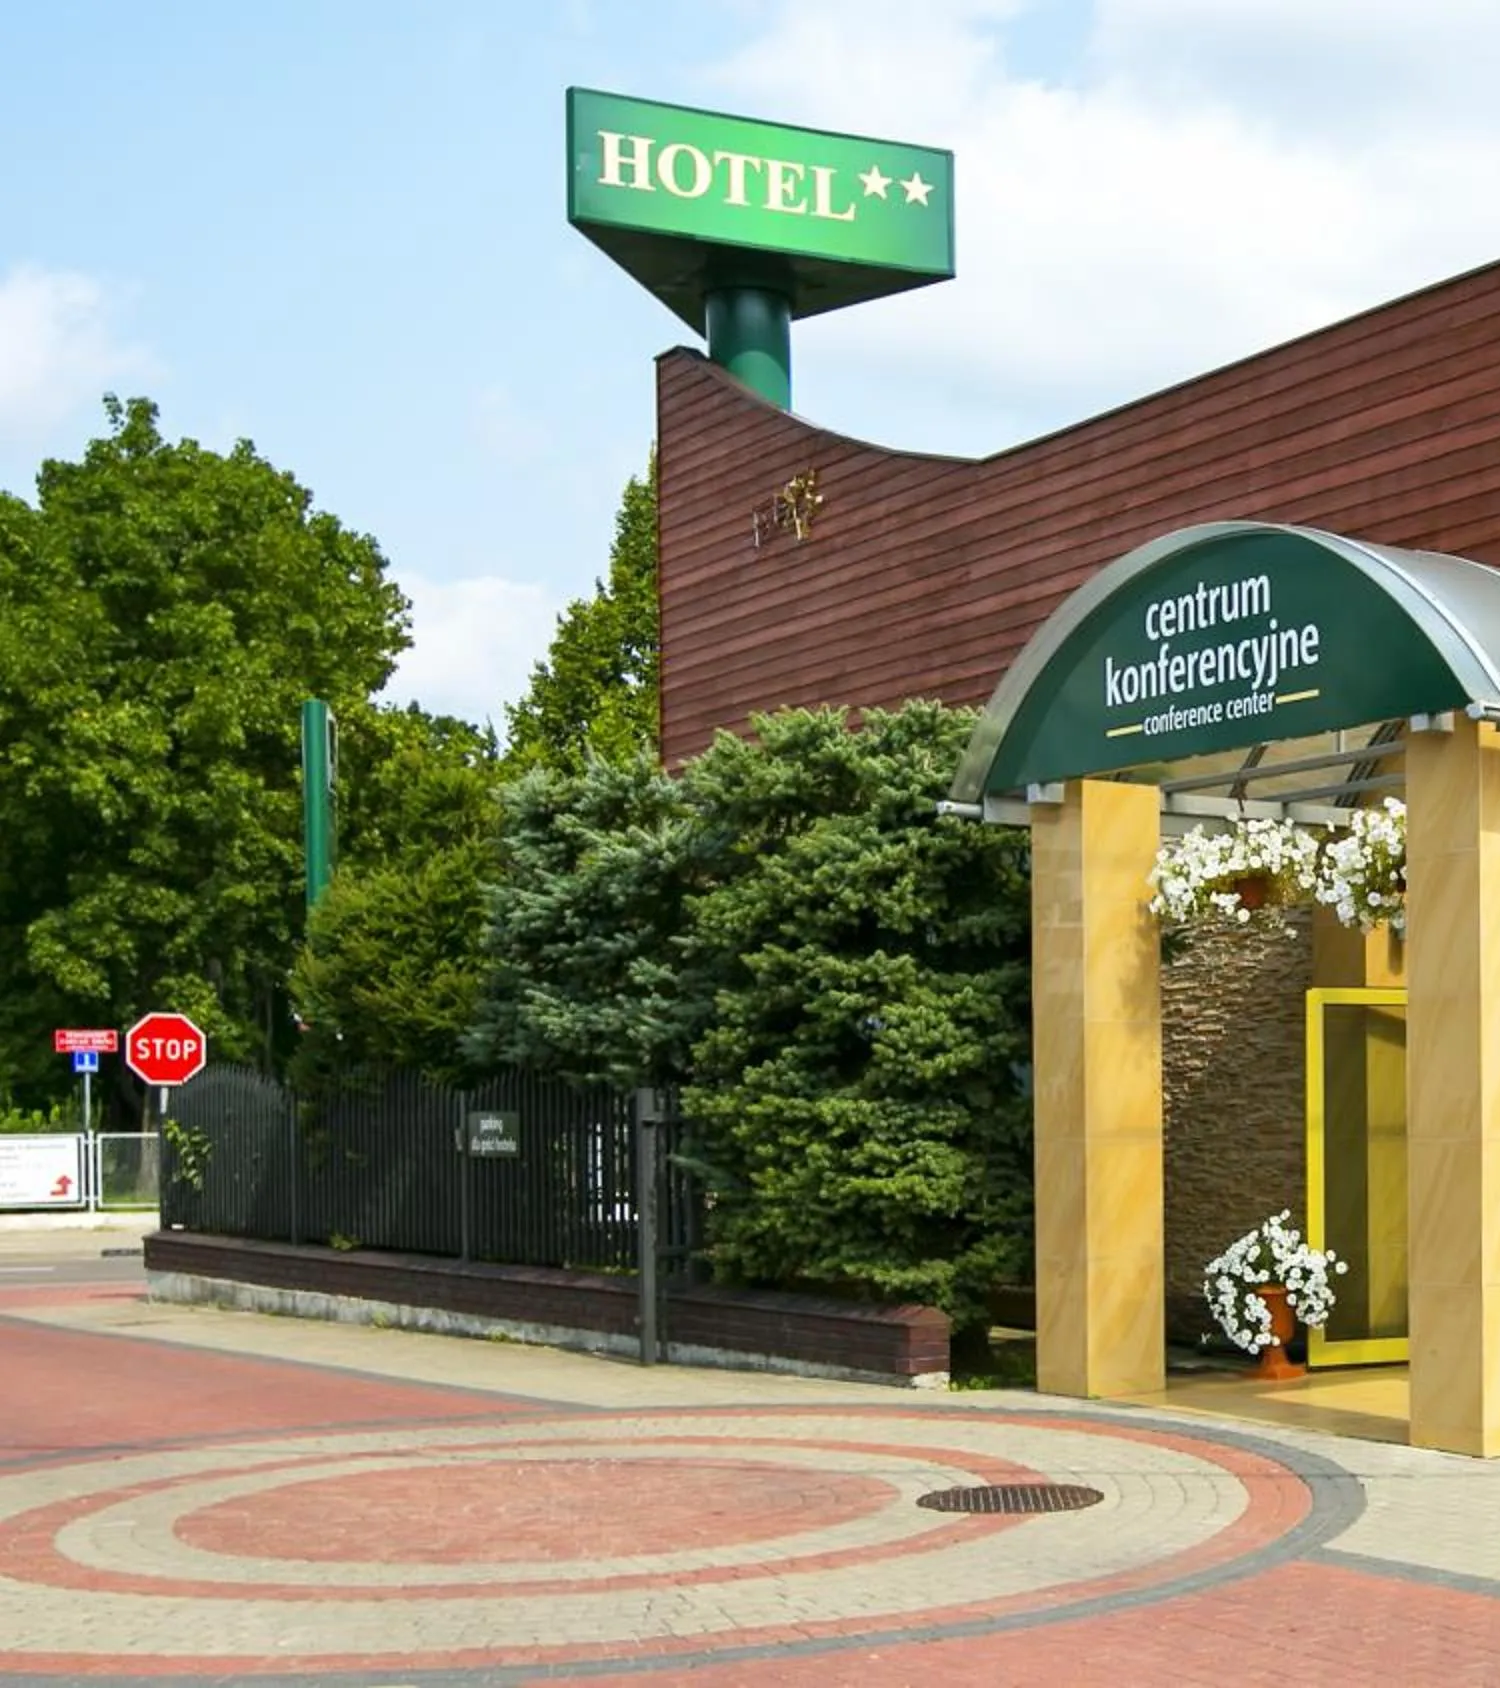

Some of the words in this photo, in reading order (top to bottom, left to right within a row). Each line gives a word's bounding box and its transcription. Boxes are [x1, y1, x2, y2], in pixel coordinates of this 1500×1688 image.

[598, 130, 857, 222] HOTEL
[1145, 574, 1270, 641] centrum
[1105, 619, 1320, 707] konferencyjne
[1143, 704, 1223, 736] conference
[1226, 691, 1276, 719] center
[136, 1038, 197, 1060] STOP
